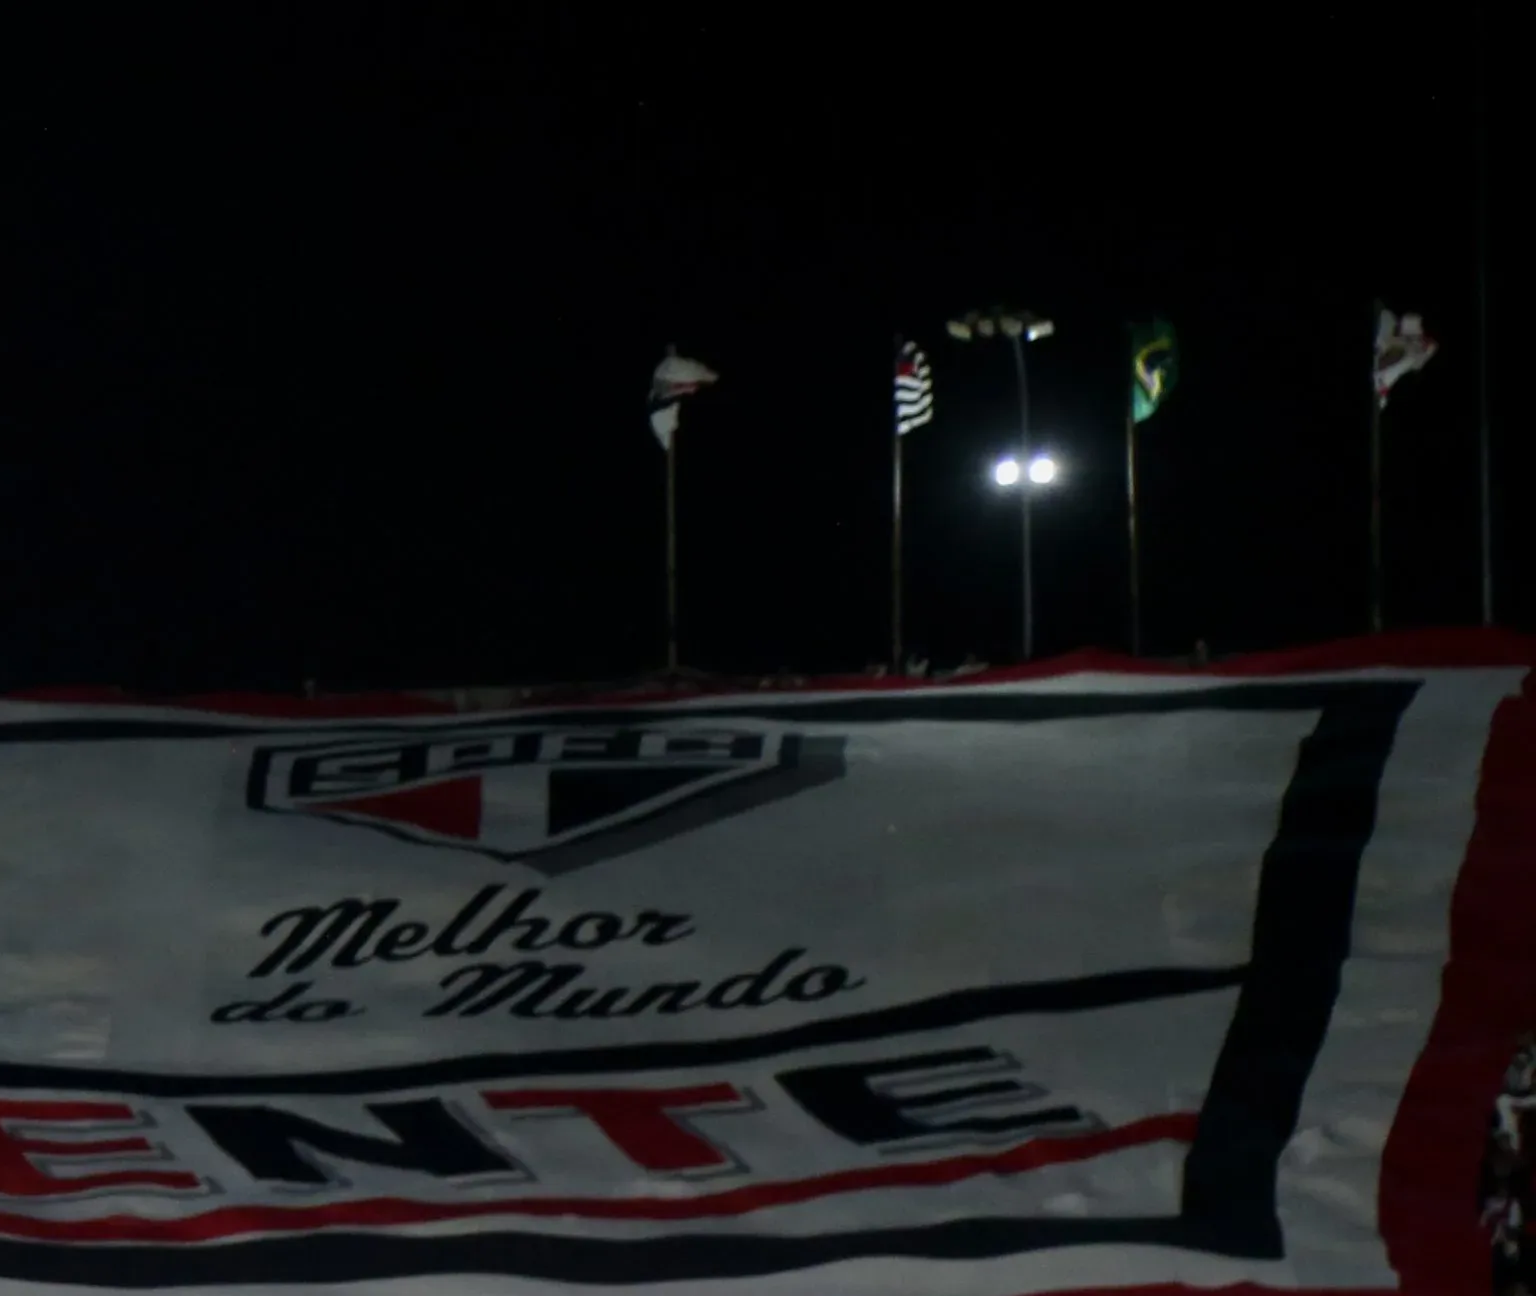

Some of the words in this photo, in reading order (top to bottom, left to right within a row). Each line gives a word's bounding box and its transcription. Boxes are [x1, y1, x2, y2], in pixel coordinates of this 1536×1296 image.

[247, 884, 695, 979] Melhor
[211, 982, 366, 1025] do
[416, 948, 865, 1022] Mundo
